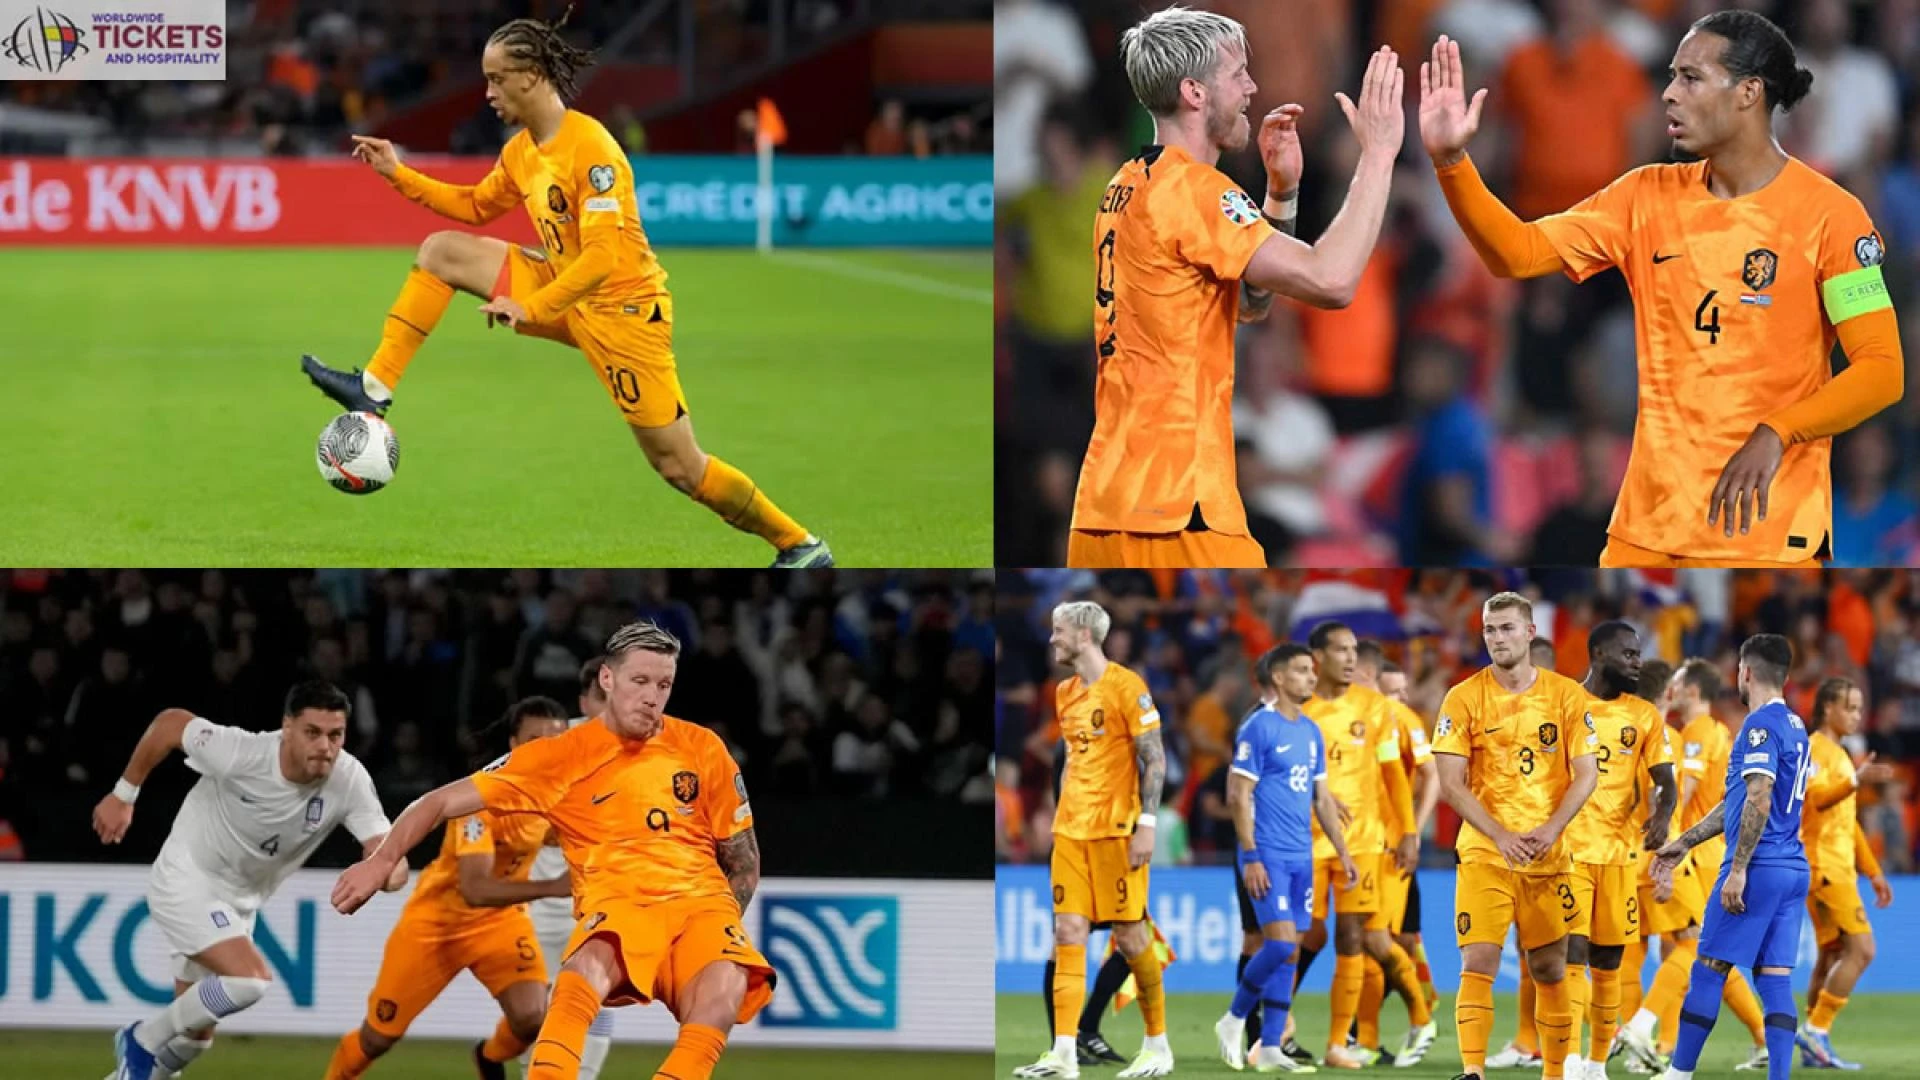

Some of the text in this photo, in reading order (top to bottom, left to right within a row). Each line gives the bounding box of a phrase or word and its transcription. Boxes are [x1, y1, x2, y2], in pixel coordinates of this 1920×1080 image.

[0, 161, 281, 232] de KNVB
[537, 216, 564, 255] 10
[1694, 289, 1721, 345] 4
[605, 364, 641, 404] 10
[1329, 742, 1342, 765] 4
[1519, 746, 1534, 776] 3
[1596, 745, 1610, 773] 2
[260, 833, 281, 857] 4
[1116, 878, 1128, 904] 9
[1557, 883, 1576, 910] 3
[1626, 896, 1637, 923] 2
[0, 889, 316, 1007] KON
